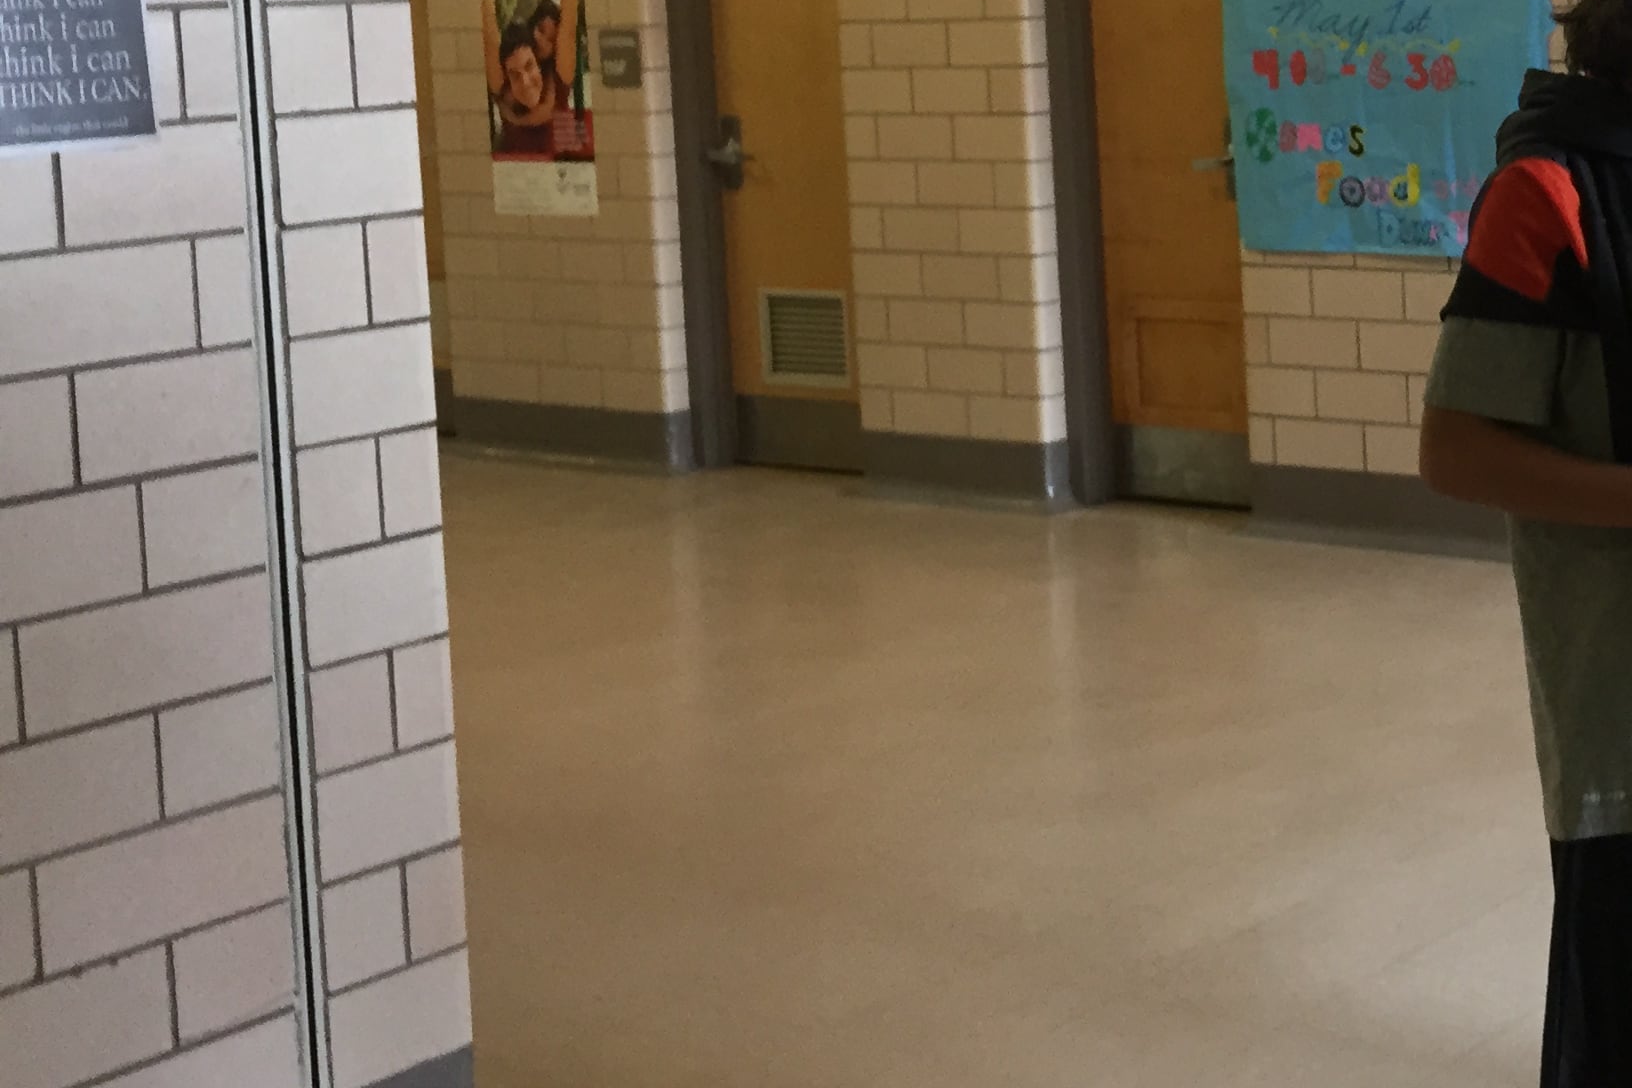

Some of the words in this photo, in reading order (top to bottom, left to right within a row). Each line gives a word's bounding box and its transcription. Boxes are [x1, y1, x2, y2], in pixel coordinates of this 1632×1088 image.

[75, 18, 116, 42] can
[1272, 0, 1370, 64] May
[87, 50, 132, 73] can
[79, 78, 86, 105] I
[1316, 160, 1420, 208] Food
